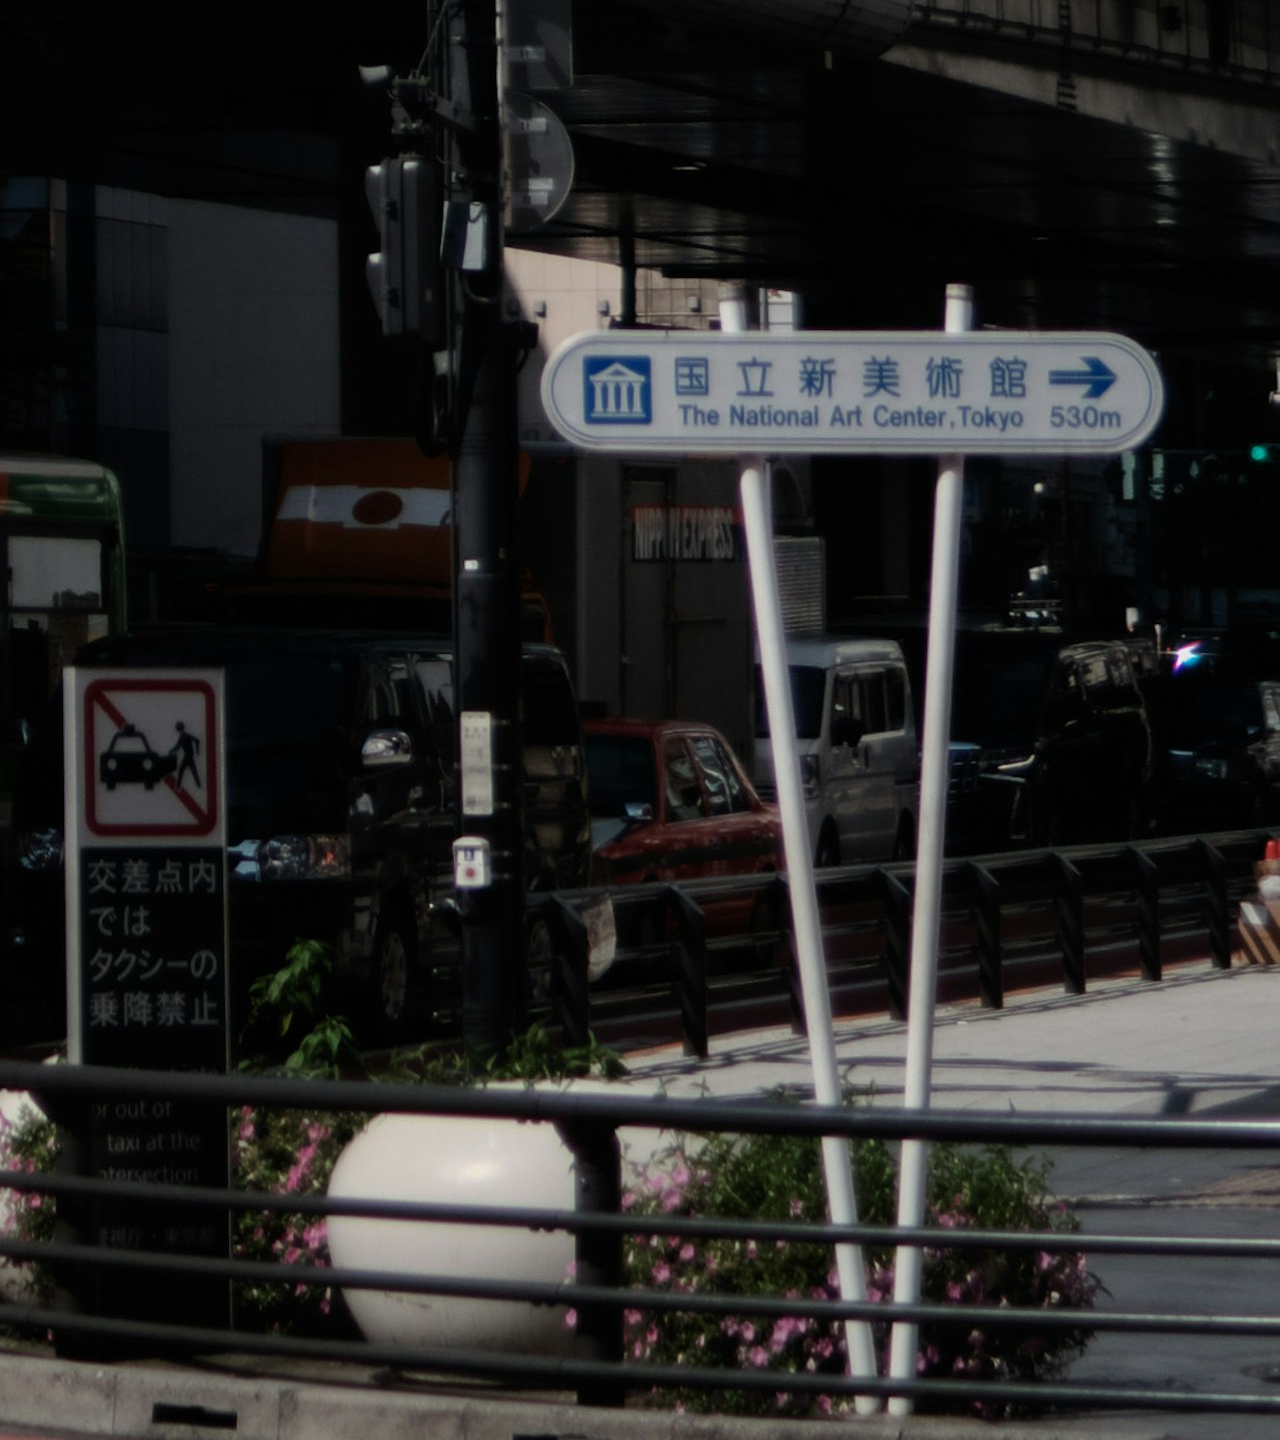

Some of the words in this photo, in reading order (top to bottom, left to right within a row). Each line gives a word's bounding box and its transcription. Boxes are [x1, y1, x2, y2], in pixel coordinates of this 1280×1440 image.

[674, 355, 1028, 399] 国立新美術館
[678, 404, 721, 429] The
[729, 404, 820, 429] National
[830, 404, 863, 429] Art
[1049, 405, 1121, 429] 530m
[87, 857, 218, 895] 交差点内
[89, 903, 152, 938] では
[89, 947, 219, 983] タクシーの
[89, 990, 220, 1027] 乗降禁止
[114, 1099, 146, 1120] out
[151, 1099, 174, 1119] of
[106, 1130, 141, 1153] taxi
[145, 1131, 165, 1152] at
[169, 1129, 201, 1152] the
